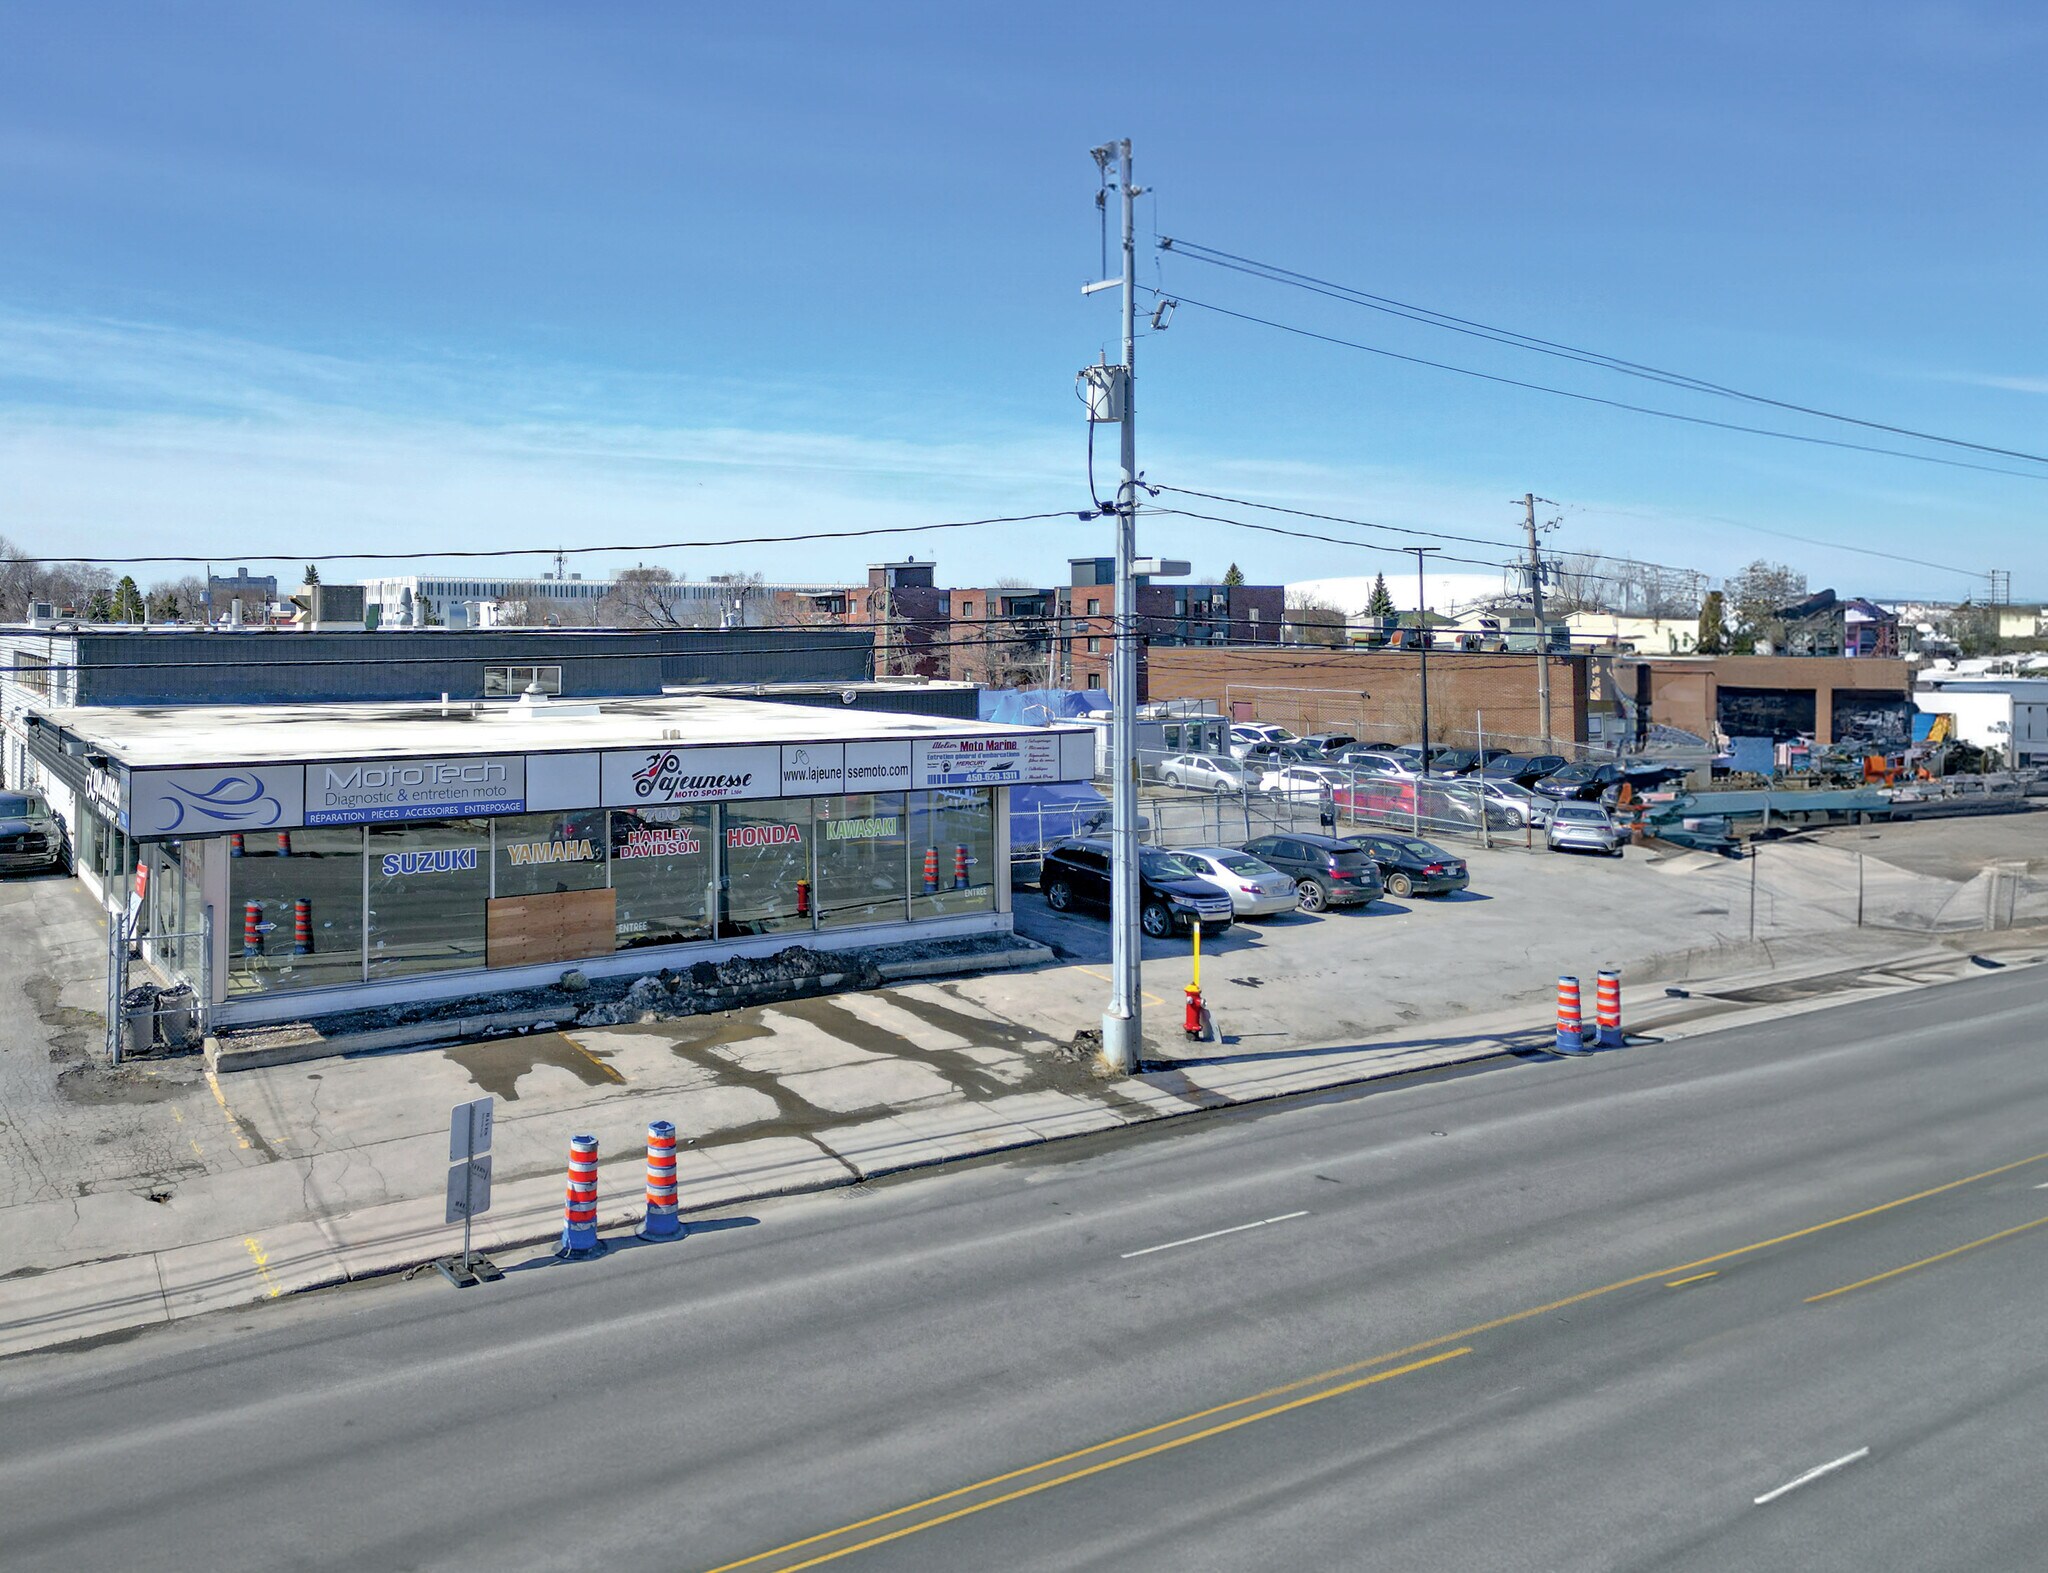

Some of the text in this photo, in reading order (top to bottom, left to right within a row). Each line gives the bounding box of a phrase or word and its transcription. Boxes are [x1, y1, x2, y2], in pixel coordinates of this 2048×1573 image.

[960, 741, 984, 752] Moto
[986, 739, 1017, 750] Marine
[326, 761, 506, 790] MotoTech
[783, 764, 909, 783] www.lajeune ssemoto.com
[325, 786, 507, 808] Diagnostic & entretien moto
[674, 790, 699, 799] MOTO
[701, 788, 728, 797] SPORT
[310, 803, 521, 823] RÉPARATION PIÈCES ACCESSOIRES ENTREPOSAGE
[645, 807, 681, 823] 700
[628, 827, 693, 845] HARLEY
[727, 823, 802, 848] HONDA
[826, 817, 897, 840] KAWASAKI
[507, 839, 594, 866] YAMAHA
[620, 840, 700, 859] DAVIDSON
[382, 848, 477, 876] SUZUKI
